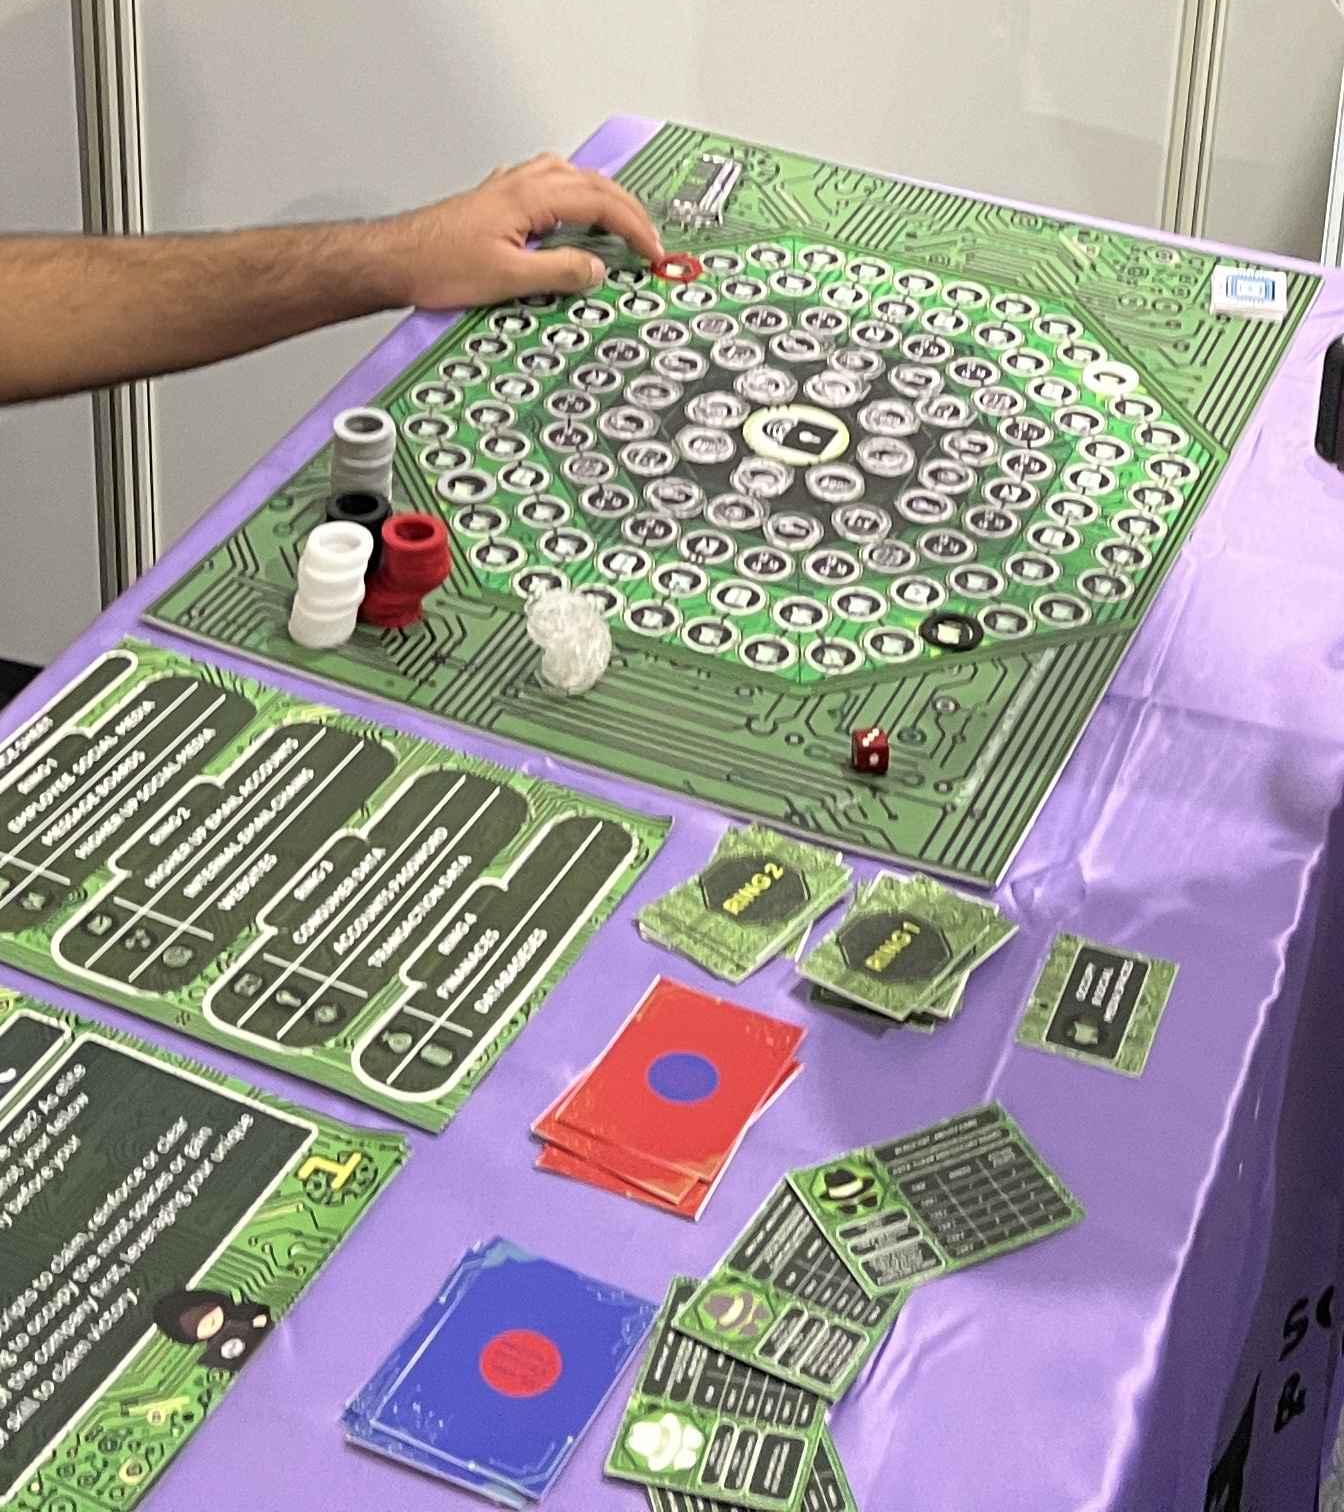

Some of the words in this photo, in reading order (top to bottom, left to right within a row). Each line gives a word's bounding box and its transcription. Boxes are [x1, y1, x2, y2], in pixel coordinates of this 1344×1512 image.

[7, 772, 76, 834] EMPLOYEE
[72, 735, 119, 776] SOCIAL
[114, 700, 156, 736] MEDIA
[135, 761, 182, 803] SOCIAL
[175, 727, 216, 766] MEDIA
[204, 794, 244, 831] EMAIL
[236, 808, 277, 846] EMAIL
[351, 847, 386, 883] DATA
[763, 862, 785, 882] 2
[367, 883, 446, 968] TRANSACTION
[438, 855, 472, 890] DATA
[37, 1093, 60, 1116] As
[55, 1063, 87, 1097] elite
[18, 1132, 51, 1170] your
[46, 1092, 89, 1137] fellow
[297, 1148, 359, 1190] 1
[3, 1165, 54, 1215] before
[48, 1134, 81, 1172] your
[31, 1270, 54, 1292] to
[87, 1166, 147, 1232] reinforce
[142, 1149, 159, 1170] or
[156, 1115, 188, 1154] clear
[7, 1332, 30, 1353] to
[26, 1279, 80, 1336] occupy
[72, 1254, 101, 1283] the
[96, 1217, 134, 1258] most
[128, 1171, 174, 1222] spaces
[169, 1153, 186, 1174] or
[183, 1126, 213, 1160] gain
[7, 1360, 38, 1391] the
[34, 1294, 99, 1365] company
[119, 1187, 192, 1269] leveraging
[182, 1157, 214, 1197] your
[210, 1113, 254, 1163] unique
[31, 1380, 55, 1401] to
[51, 1339, 92, 1383] claim
